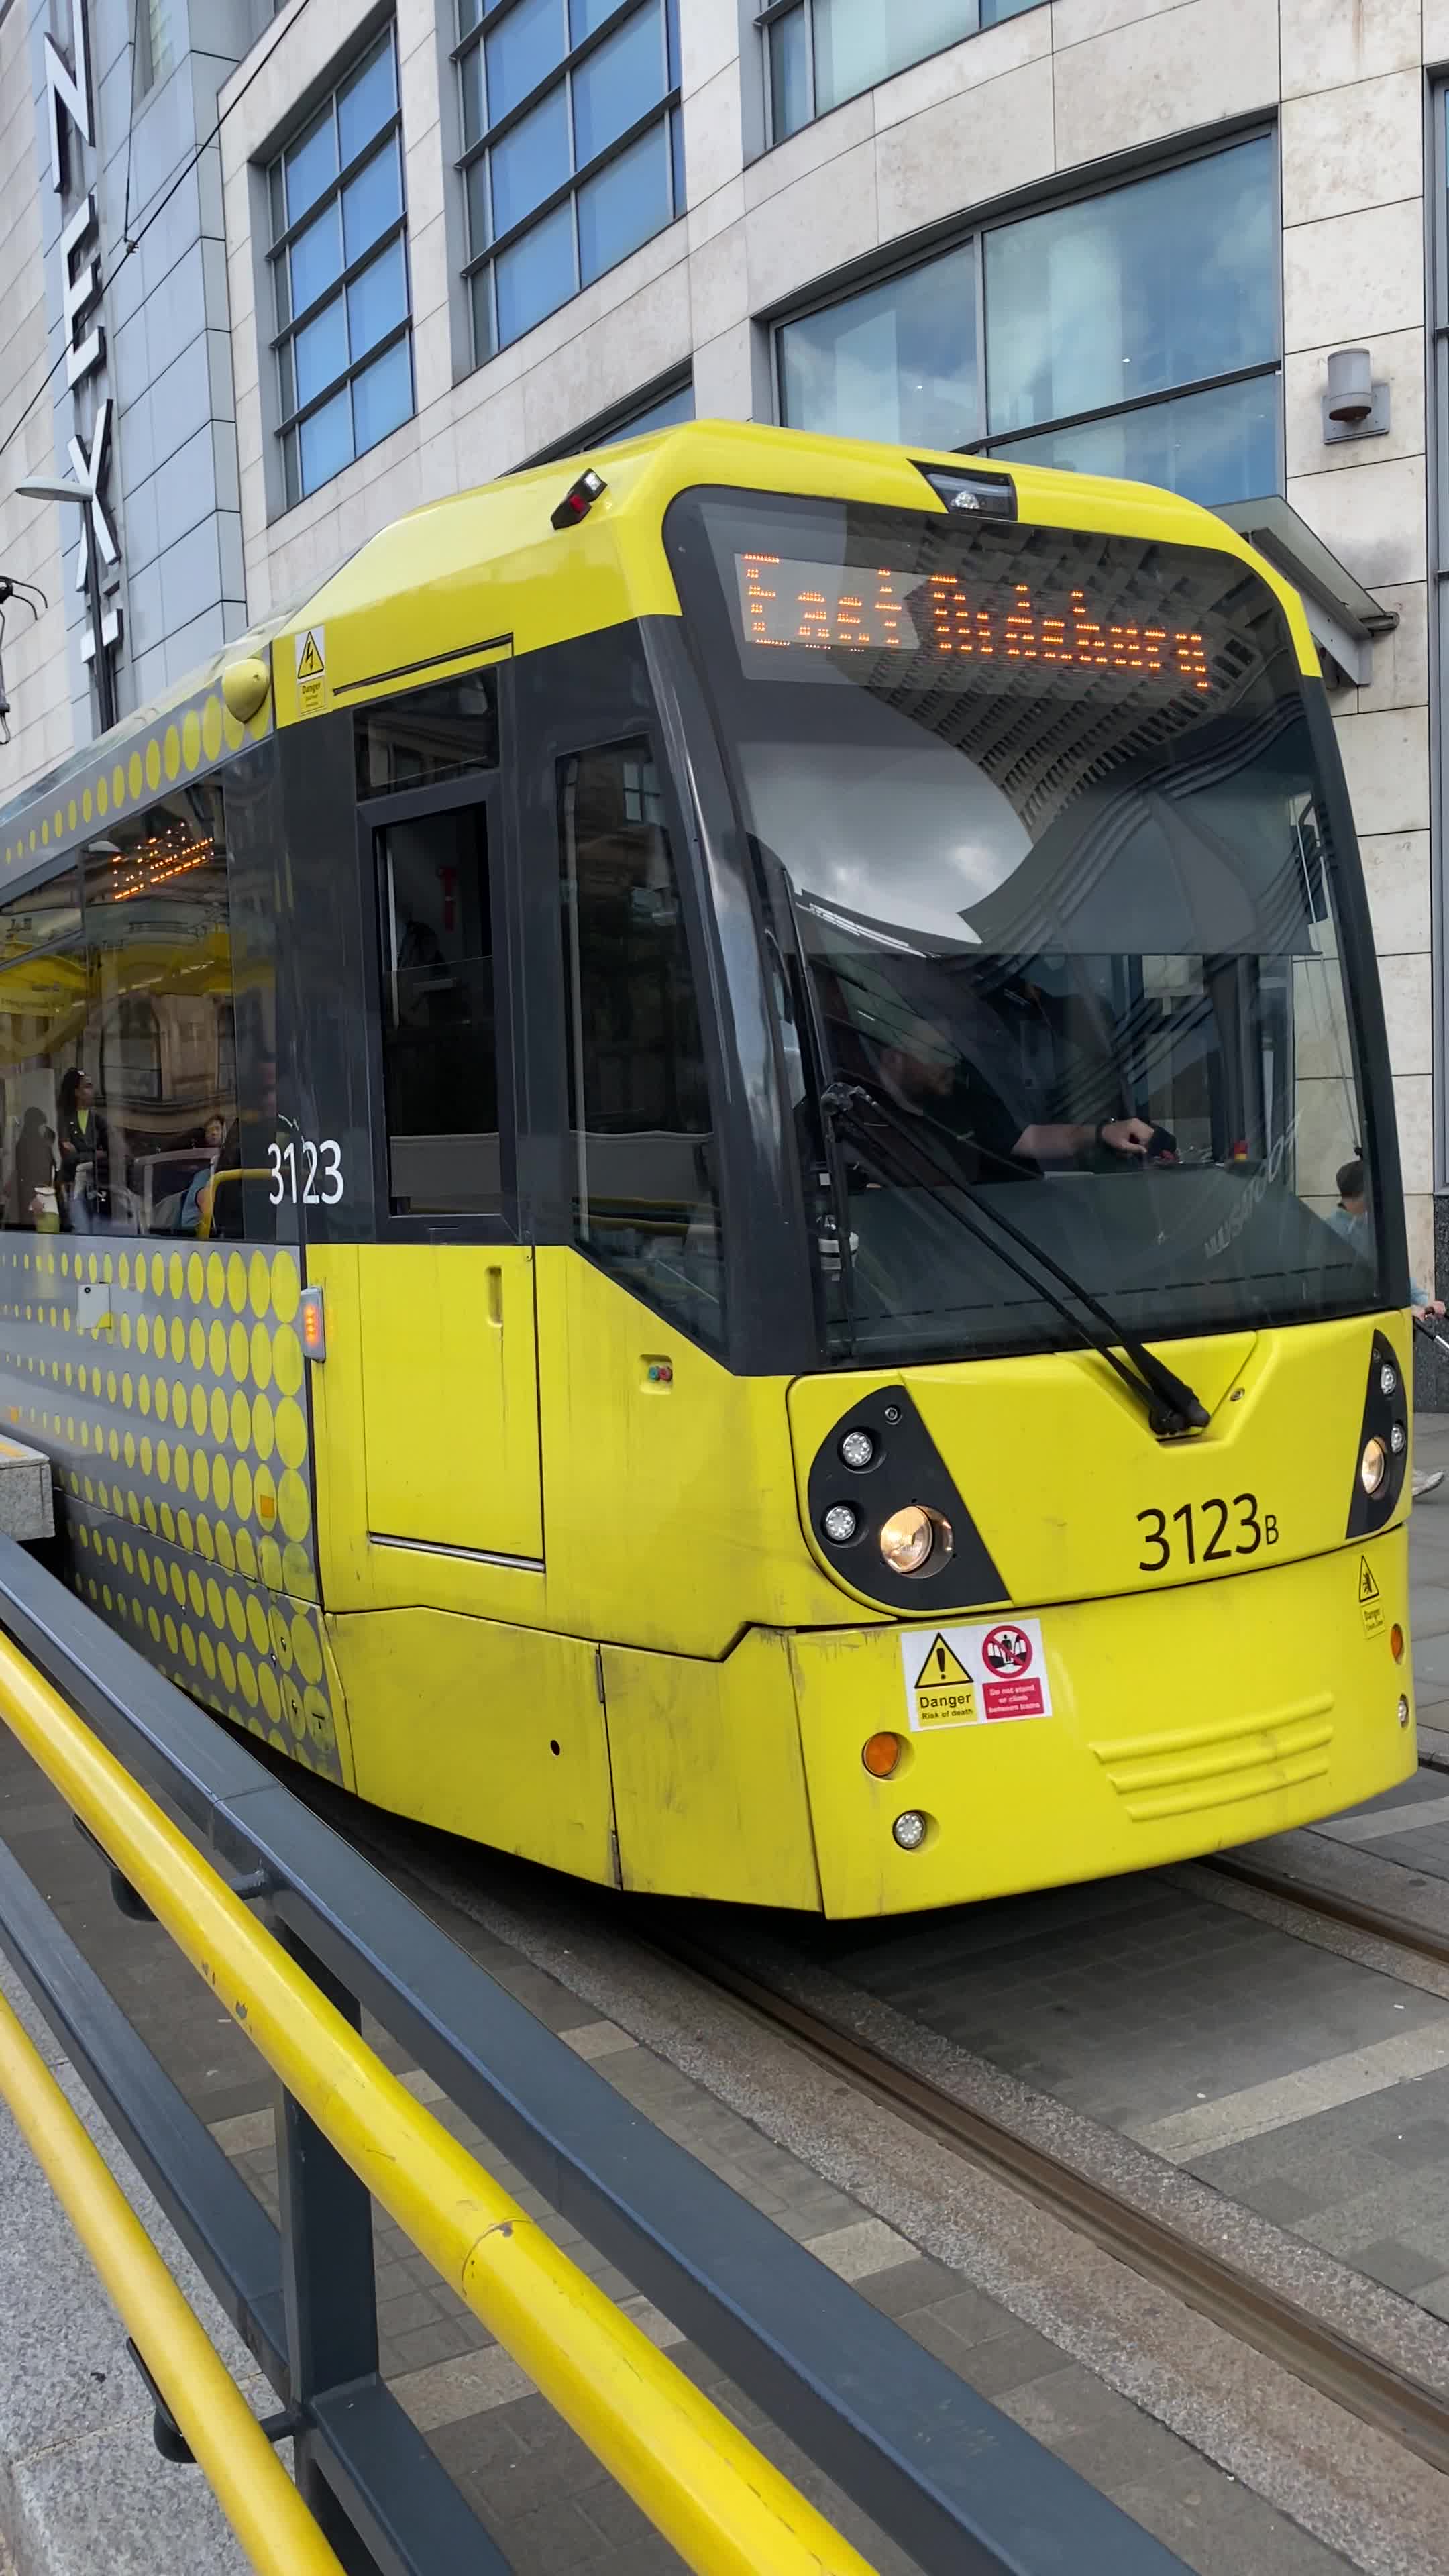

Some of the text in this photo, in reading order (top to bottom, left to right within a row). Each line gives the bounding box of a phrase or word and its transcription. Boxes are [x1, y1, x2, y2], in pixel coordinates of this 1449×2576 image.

[743, 552, 903, 649] East
[268, 1140, 344, 1205] 3123
[919, 1694, 972, 1709] Danger
[941, 1710, 950, 1718] of
[951, 1708, 973, 1717] death
